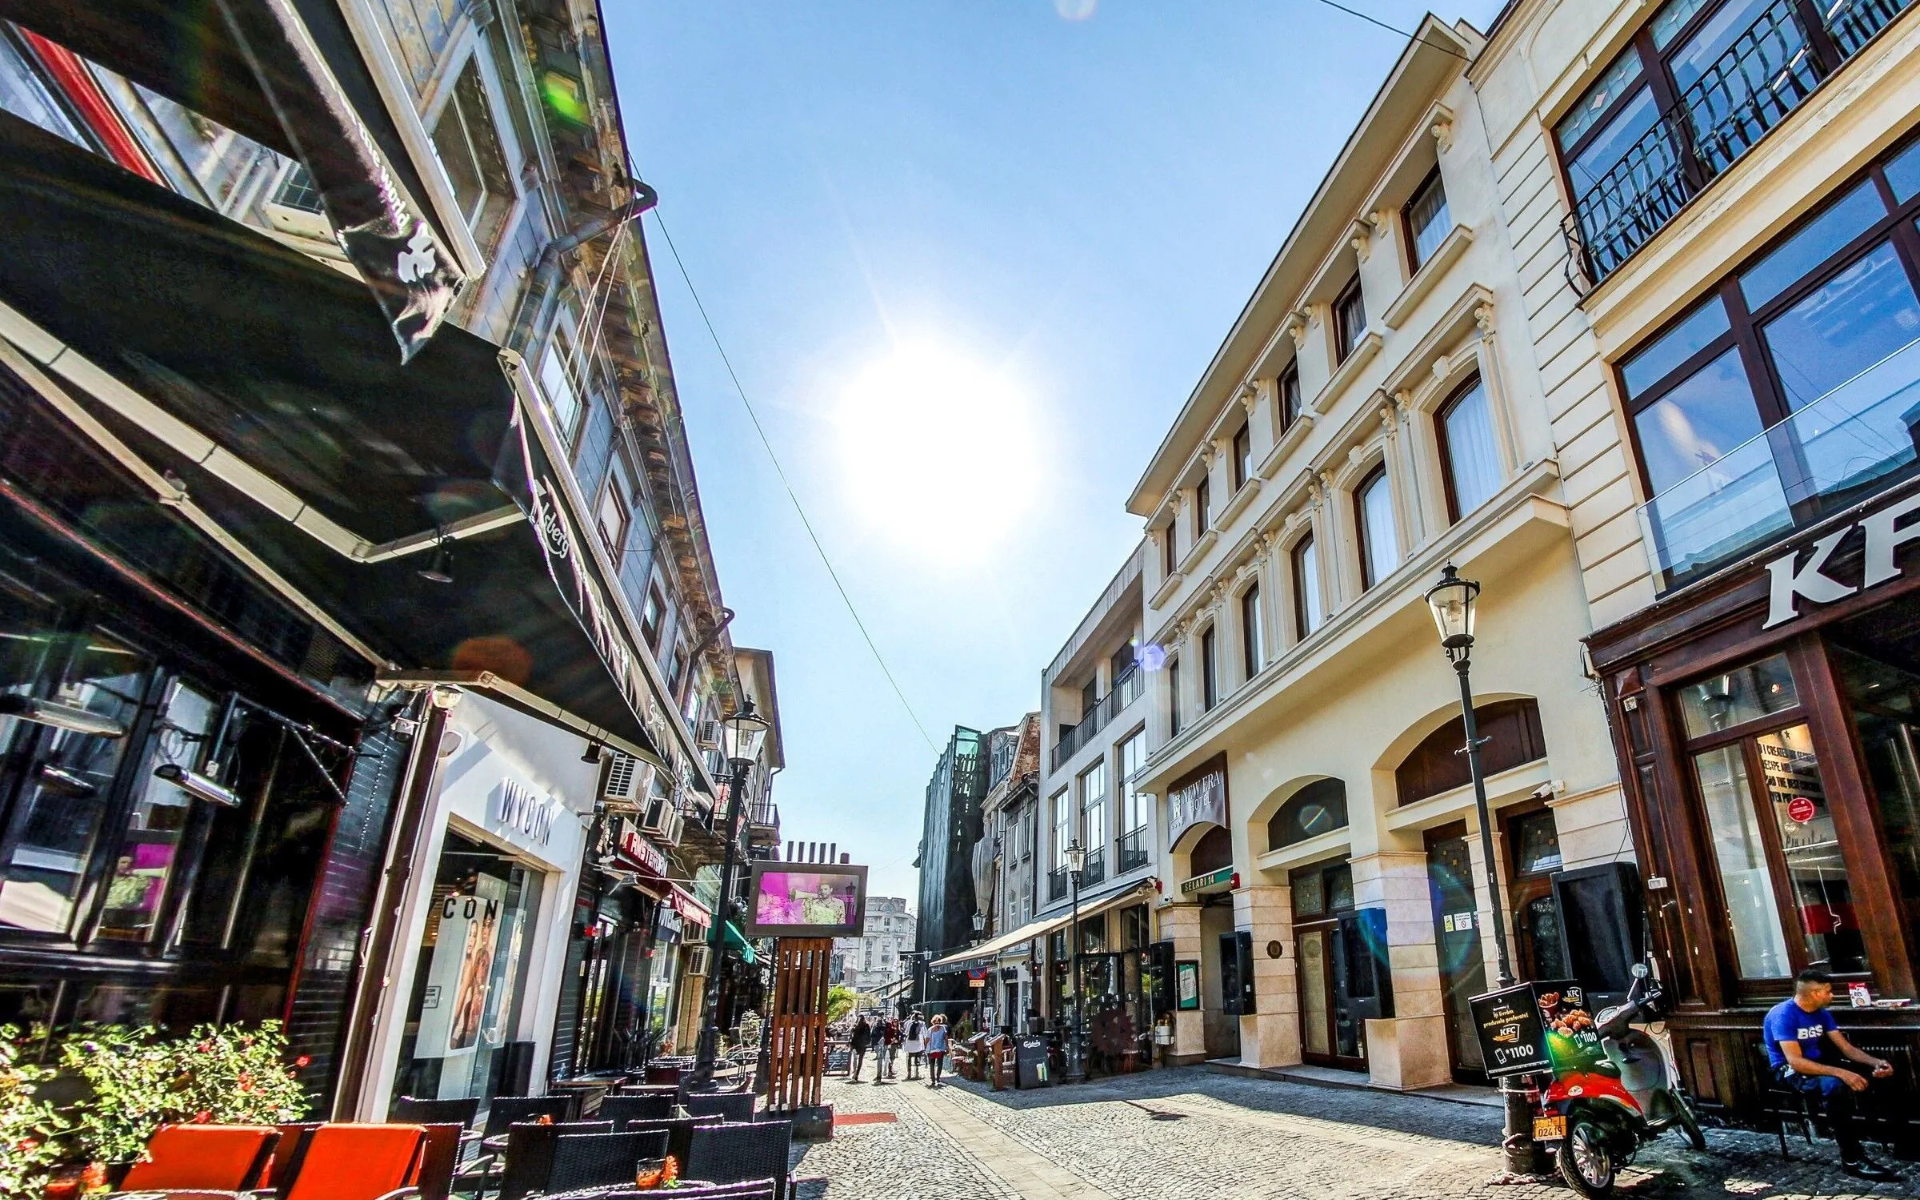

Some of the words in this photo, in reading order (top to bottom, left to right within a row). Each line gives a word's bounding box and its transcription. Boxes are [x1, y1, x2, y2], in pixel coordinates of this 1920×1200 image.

[539, 502, 571, 560] lsberg
[1202, 770, 1221, 793] ERA
[498, 778, 554, 847] WYCON
[1566, 989, 1579, 997] KFC
[1500, 1026, 1516, 1036] KFC
[1797, 1024, 1823, 1040] BGS
